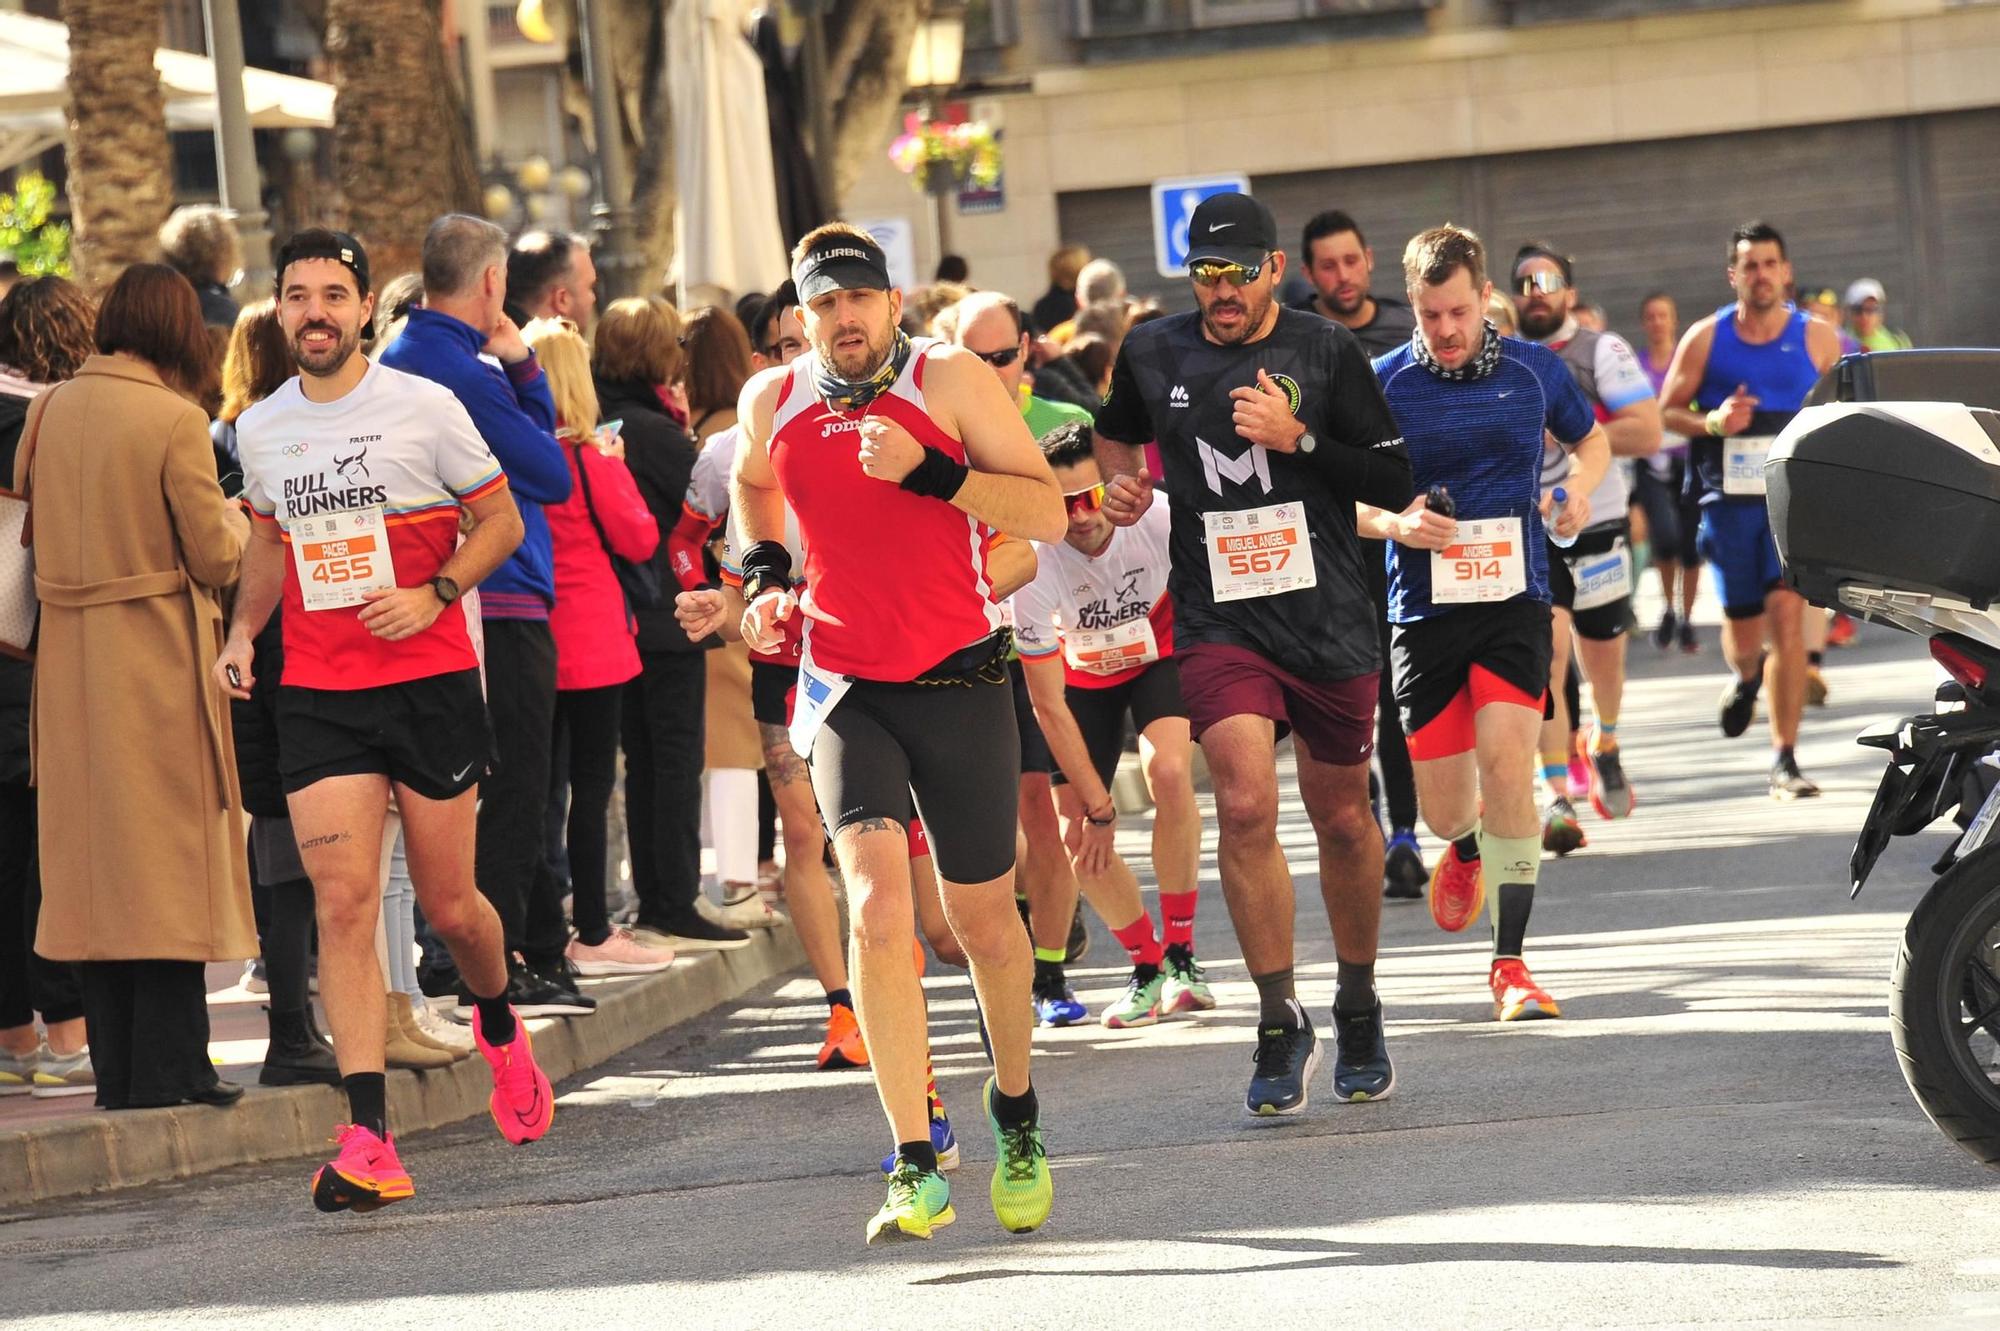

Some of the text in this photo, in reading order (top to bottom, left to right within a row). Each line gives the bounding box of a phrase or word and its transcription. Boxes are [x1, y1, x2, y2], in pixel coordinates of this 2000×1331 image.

[817, 247, 870, 262] LURBEL
[349, 434, 382, 445] FASTER
[284, 472, 328, 499] BULL
[287, 484, 387, 519] RUNNERS
[321, 541, 350, 558] PACER
[1226, 536, 1258, 552] MIGUEL
[1259, 532, 1288, 549] ANGEL
[312, 556, 373, 584] 455
[1228, 548, 1290, 575] 567
[1455, 560, 1501, 580] 914
